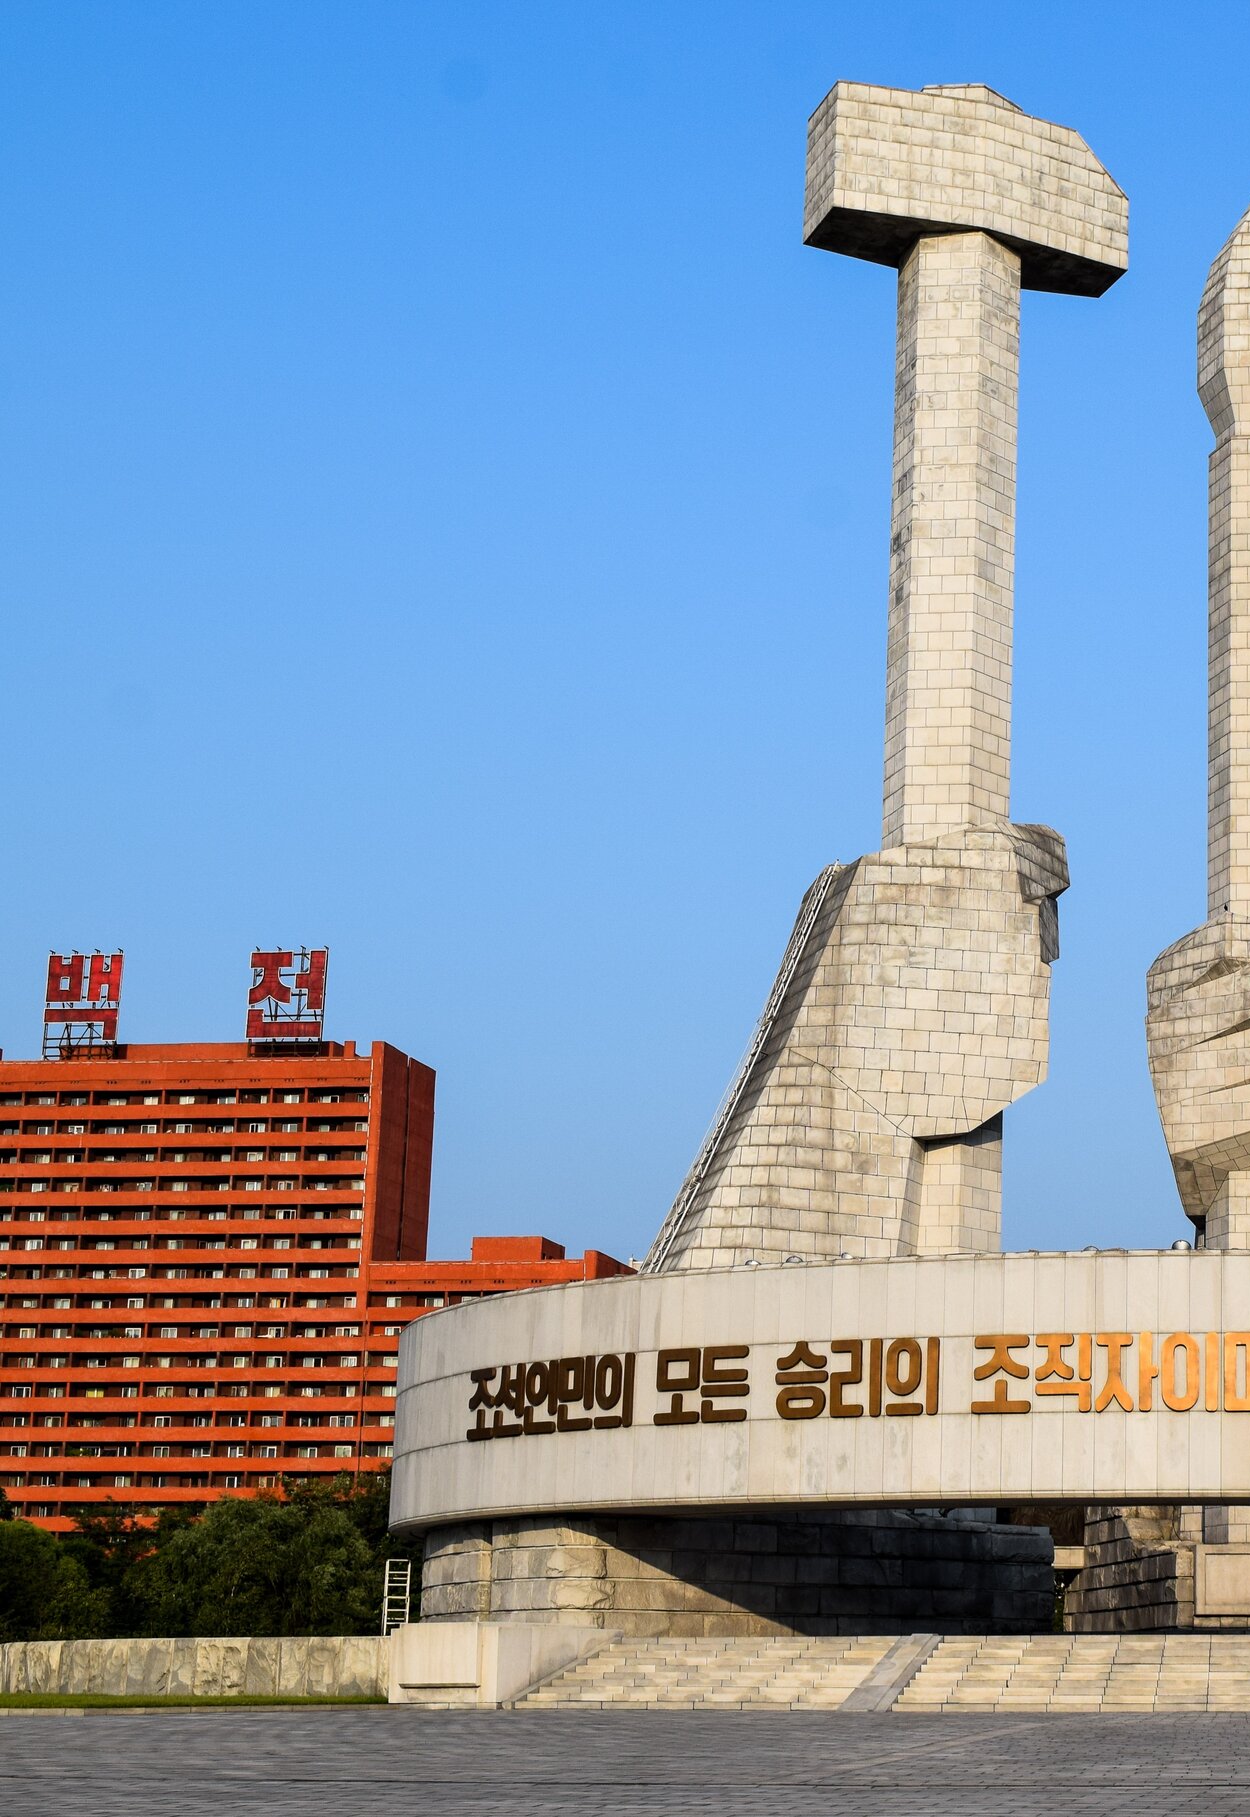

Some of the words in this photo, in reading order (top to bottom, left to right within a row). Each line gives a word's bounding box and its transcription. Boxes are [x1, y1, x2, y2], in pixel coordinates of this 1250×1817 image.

[44, 953, 124, 1041] 백
[246, 949, 328, 1039] 전
[466, 1352, 636, 1442] 조선인민의
[653, 1344, 751, 1425] 모든
[775, 1336, 941, 1420] 승리의
